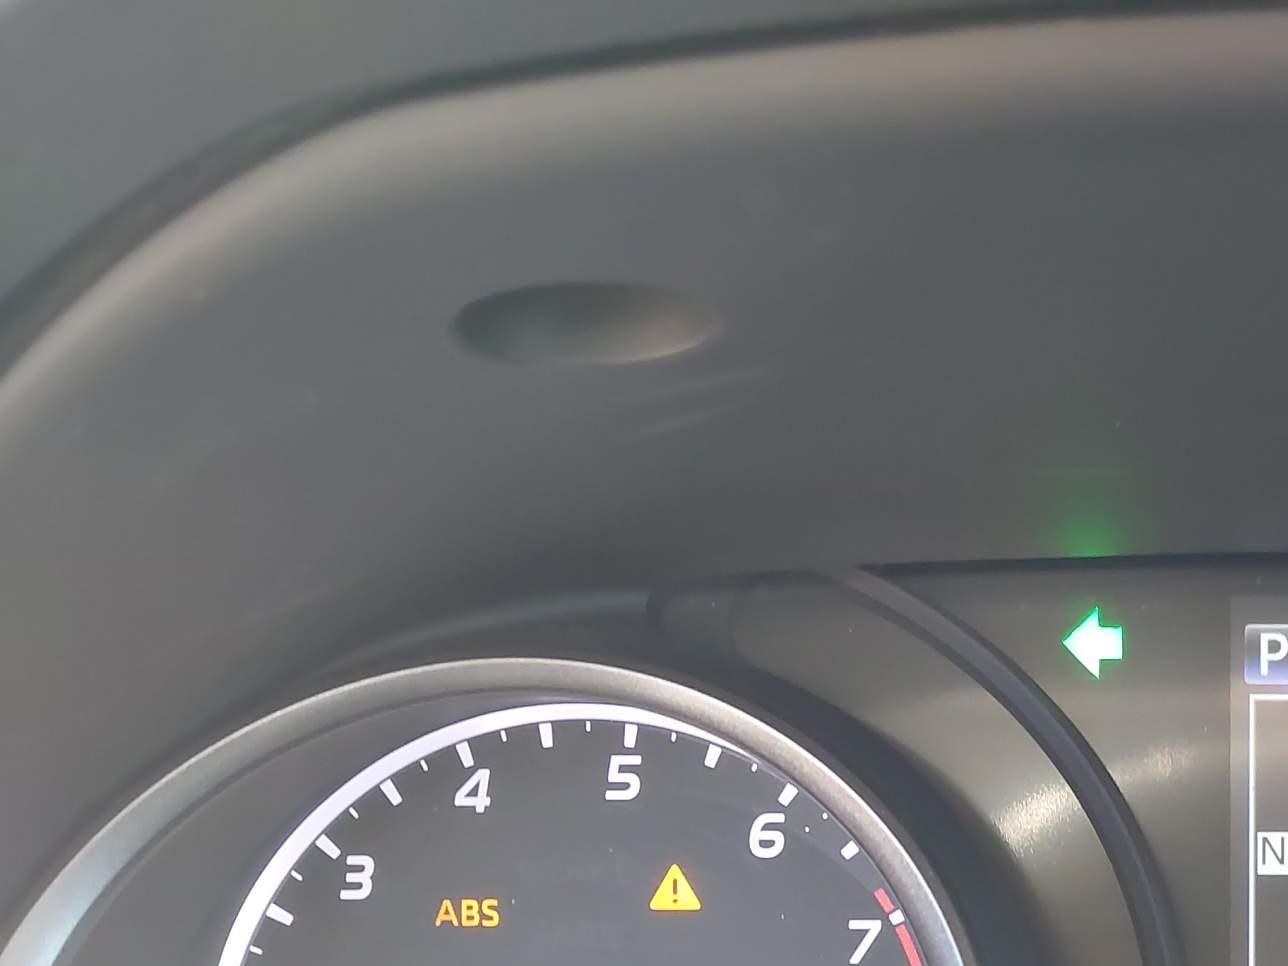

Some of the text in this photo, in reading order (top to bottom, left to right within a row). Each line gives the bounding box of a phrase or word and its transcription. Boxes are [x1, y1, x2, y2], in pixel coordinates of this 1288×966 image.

[1258, 632, 1288, 676] P
[453, 768, 492, 813] 4
[604, 754, 643, 801] 5
[748, 812, 786, 859] 6
[339, 854, 376, 901] 3
[435, 898, 500, 927] ABS
[847, 919, 882, 965] 7
